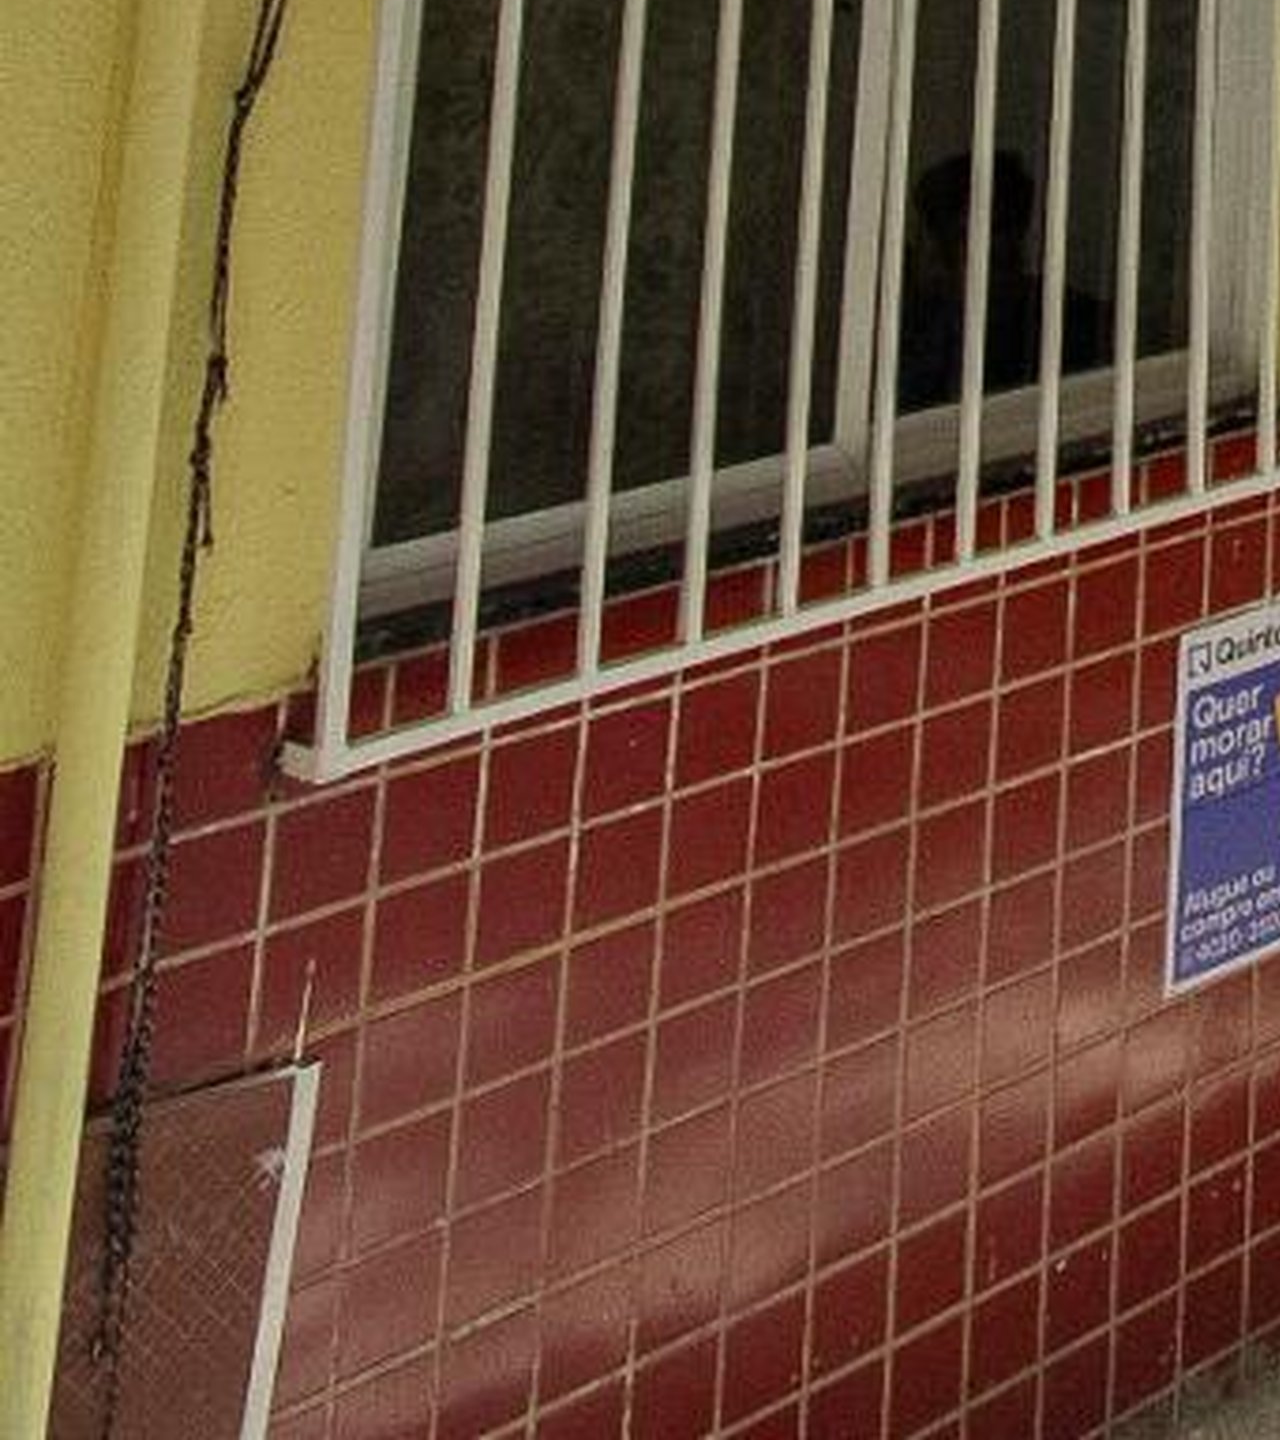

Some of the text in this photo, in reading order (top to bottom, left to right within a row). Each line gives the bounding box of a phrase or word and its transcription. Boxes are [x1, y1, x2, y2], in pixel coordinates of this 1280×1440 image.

[1193, 683, 1265, 729] Quer
[1191, 715, 1275, 766] morar
[1189, 744, 1266, 799] aqui?
